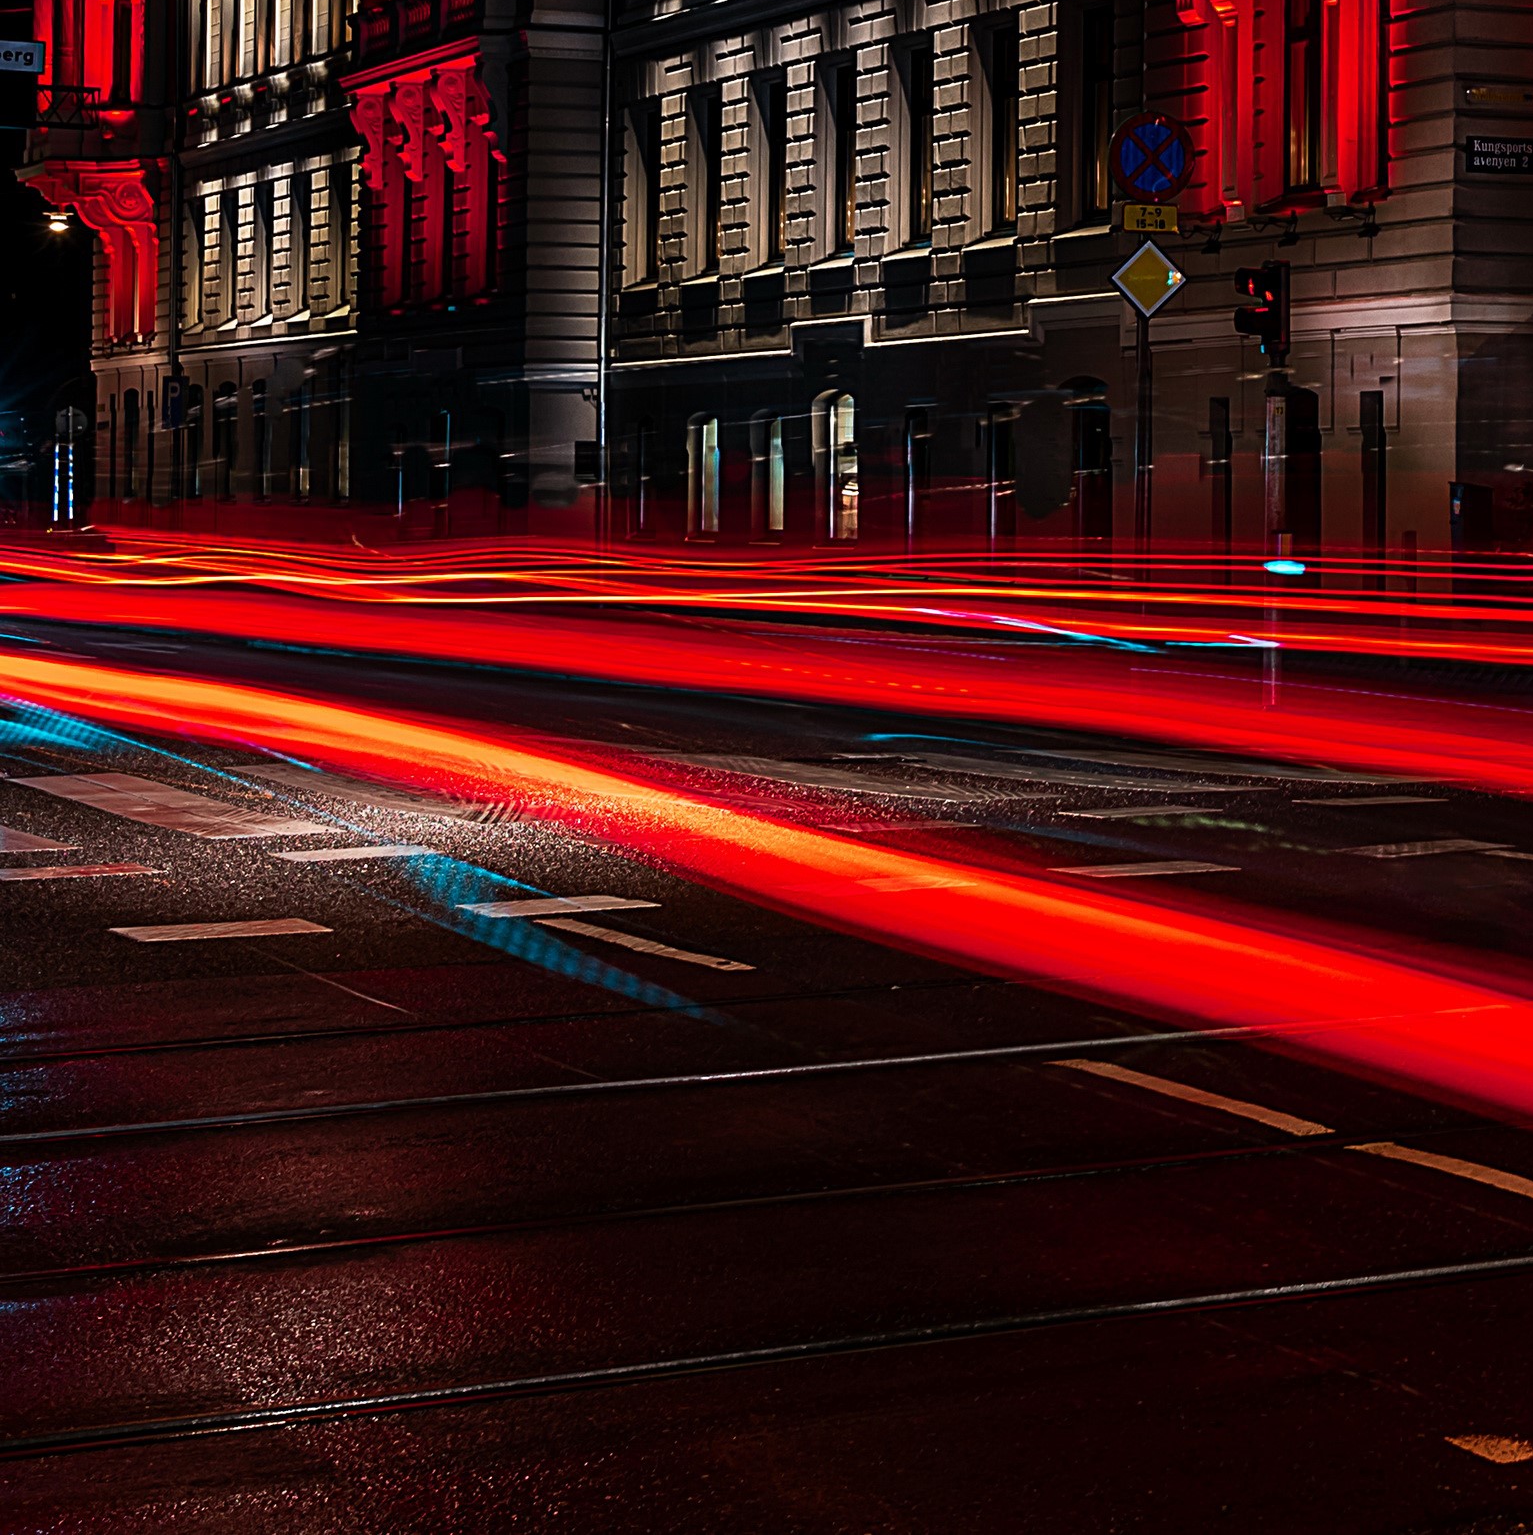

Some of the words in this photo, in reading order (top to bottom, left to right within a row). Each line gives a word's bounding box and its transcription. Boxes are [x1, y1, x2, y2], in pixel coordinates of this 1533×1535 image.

[0, 50, 34, 67] erg
[1473, 156, 1516, 169] avenyen
[1522, 155, 1529, 168] 2
[1140, 207, 1162, 217] 7-9
